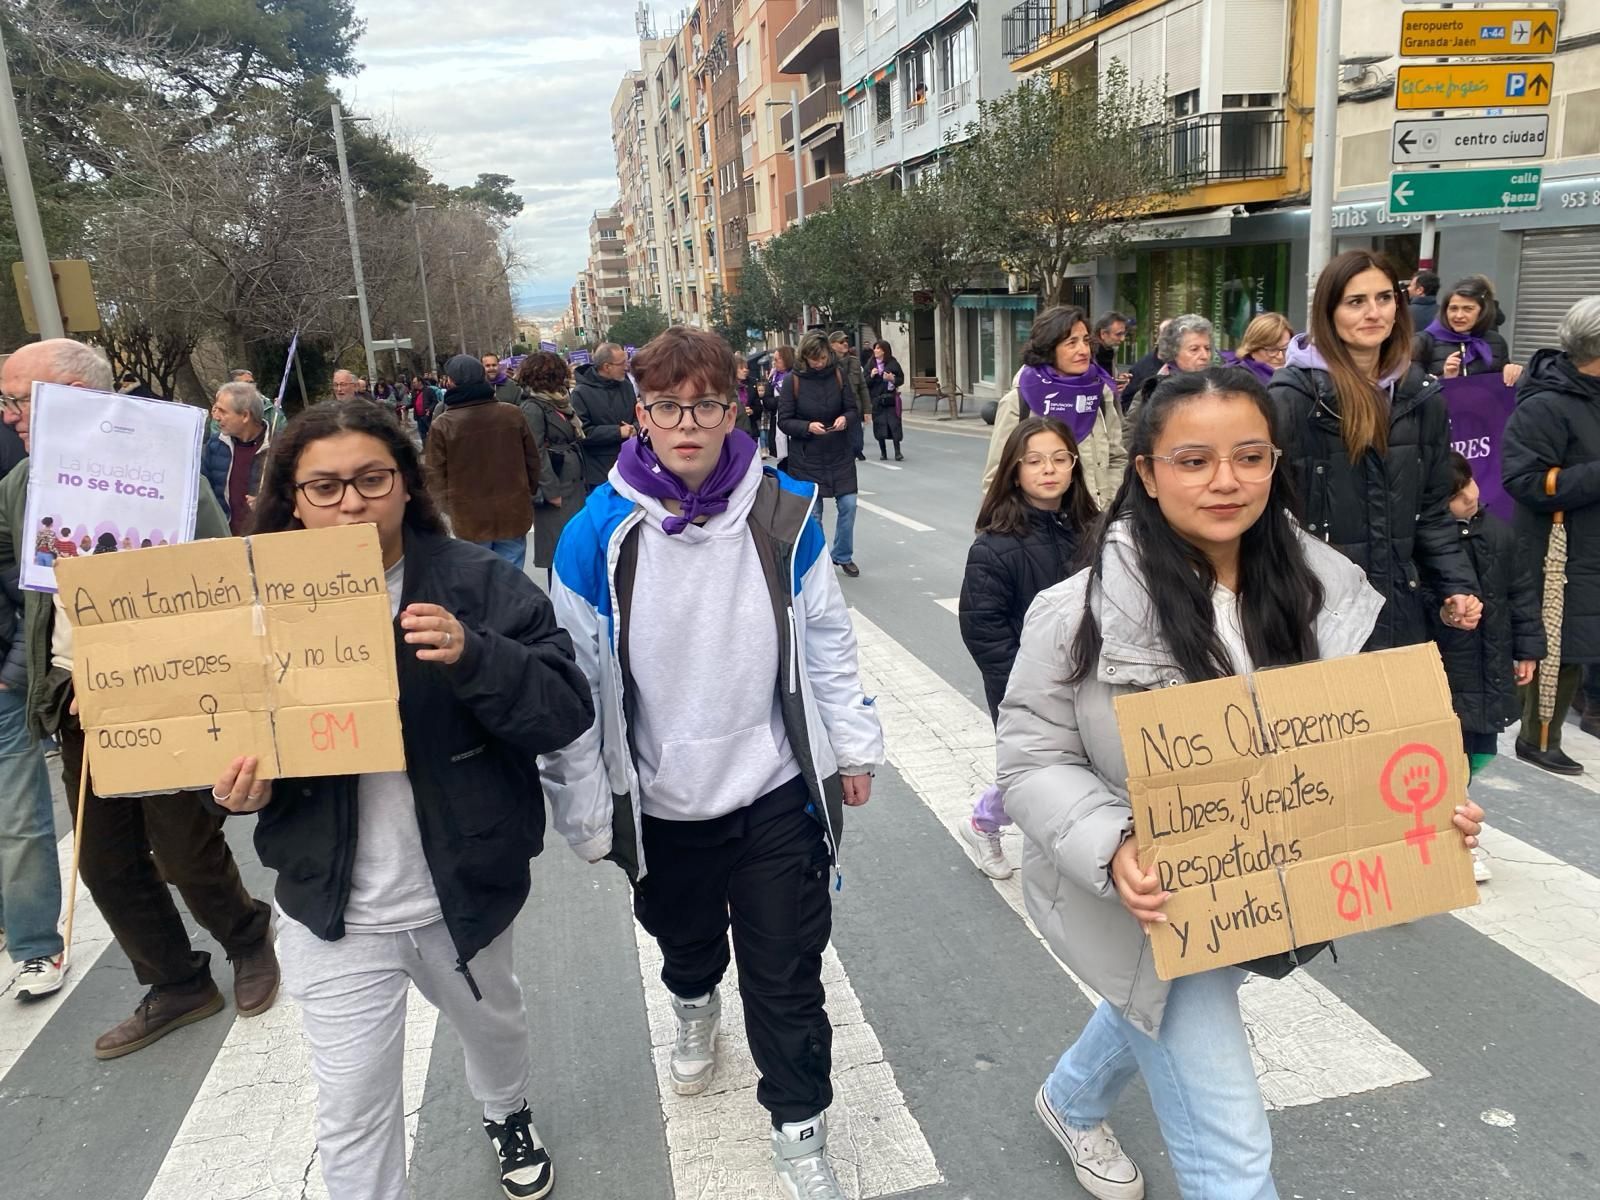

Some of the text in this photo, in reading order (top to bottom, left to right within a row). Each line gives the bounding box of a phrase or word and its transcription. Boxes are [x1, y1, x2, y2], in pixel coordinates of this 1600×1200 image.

[1406, 21, 1463, 31] aeropuerto
[1481, 28, 1505, 38] A-44
[1509, 75, 1525, 95] P
[1455, 130, 1545, 146] centro ciudad
[1511, 172, 1539, 184] calle
[1561, 192, 1586, 208] 953
[1450, 436, 1490, 460] RES
[58, 454, 166, 484] La igualdad
[57, 472, 165, 500] no se toca.
[74, 570, 380, 626] A mi también me gustan
[86, 658, 124, 691] las
[274, 652, 291, 684] y
[305, 647, 325, 667] no
[335, 636, 370, 663] las
[99, 727, 161, 749] acoso
[308, 712, 359, 751] 8M
[1141, 723, 1213, 776] Nos
[1330, 854, 1393, 922] 8M
[1207, 890, 1283, 953] juntas
